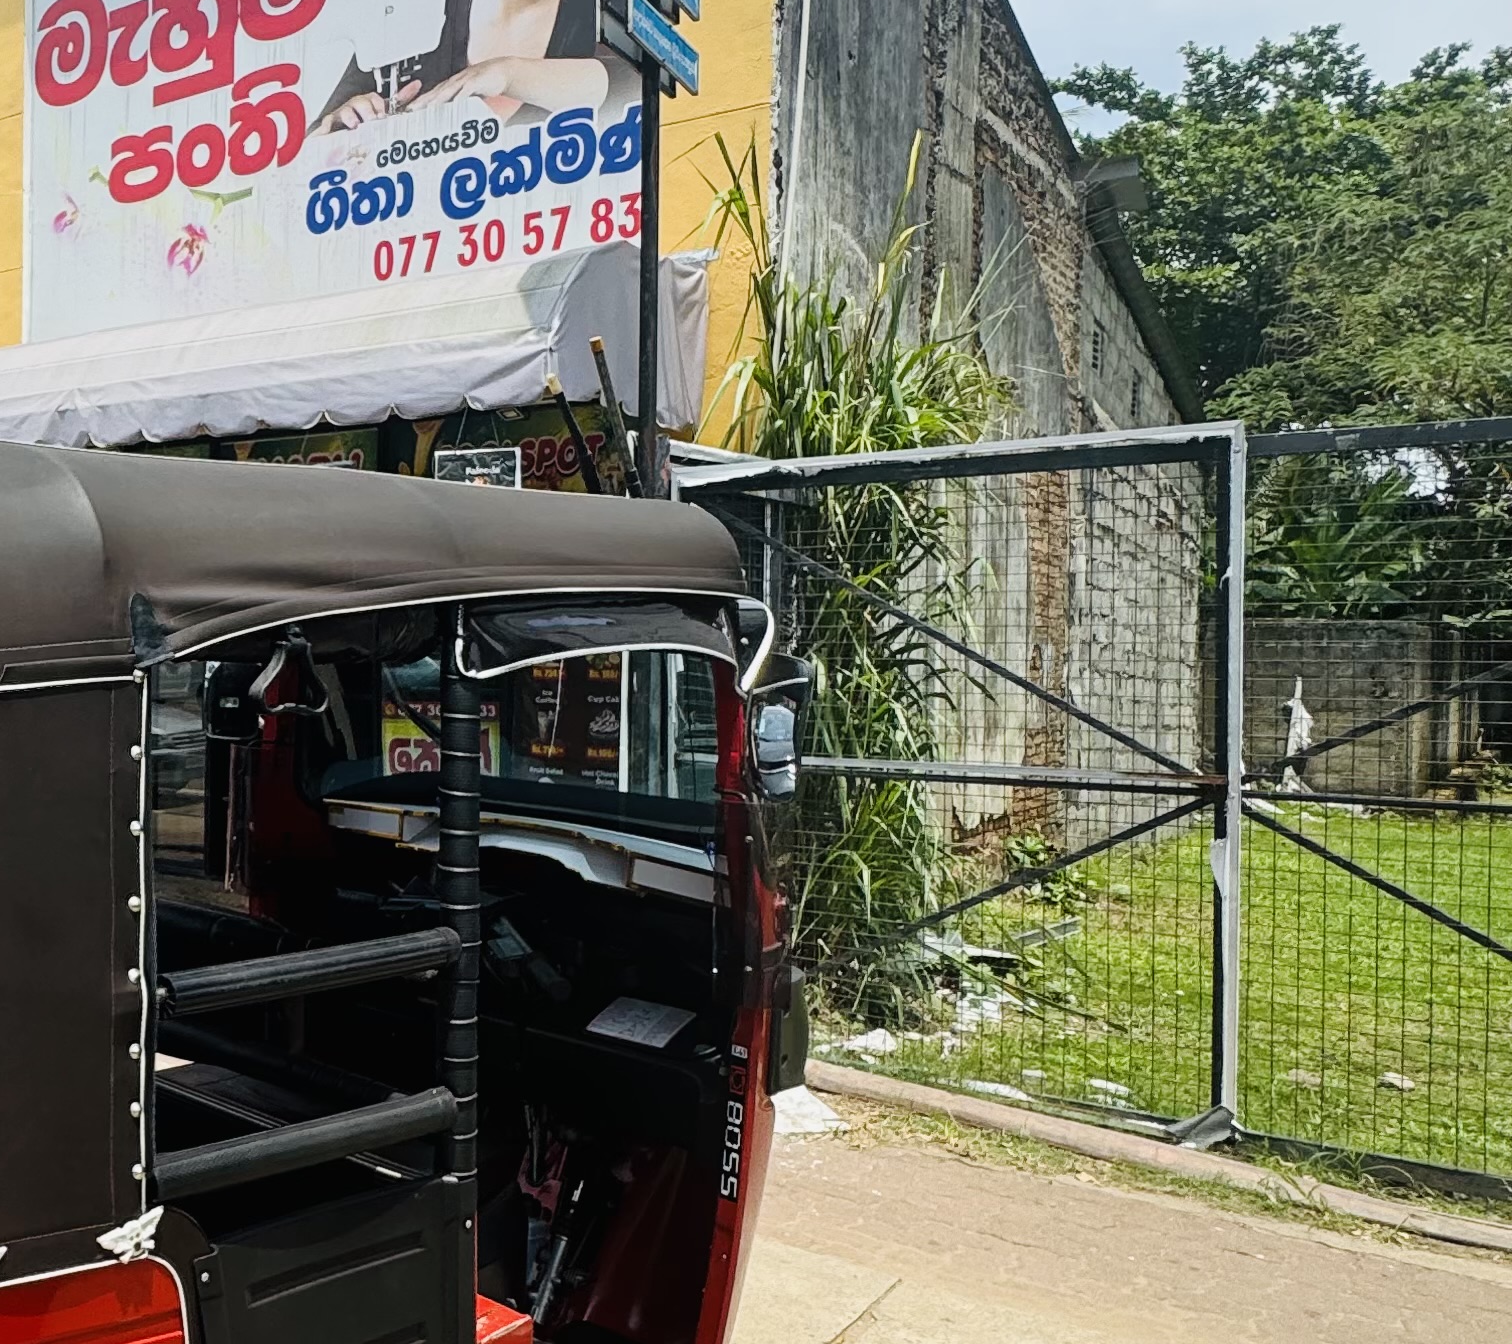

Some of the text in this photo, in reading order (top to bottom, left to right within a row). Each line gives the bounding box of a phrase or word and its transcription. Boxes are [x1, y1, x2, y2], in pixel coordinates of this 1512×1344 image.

[107, 64, 307, 204] පංති
[376, 116, 501, 168] මෙහෙයවීම
[304, 166, 414, 237] ගීතා
[373, 192, 641, 282] 077 30 57 83
[519, 432, 606, 477] SPOT
[720, 1101, 743, 1198] BOSS
